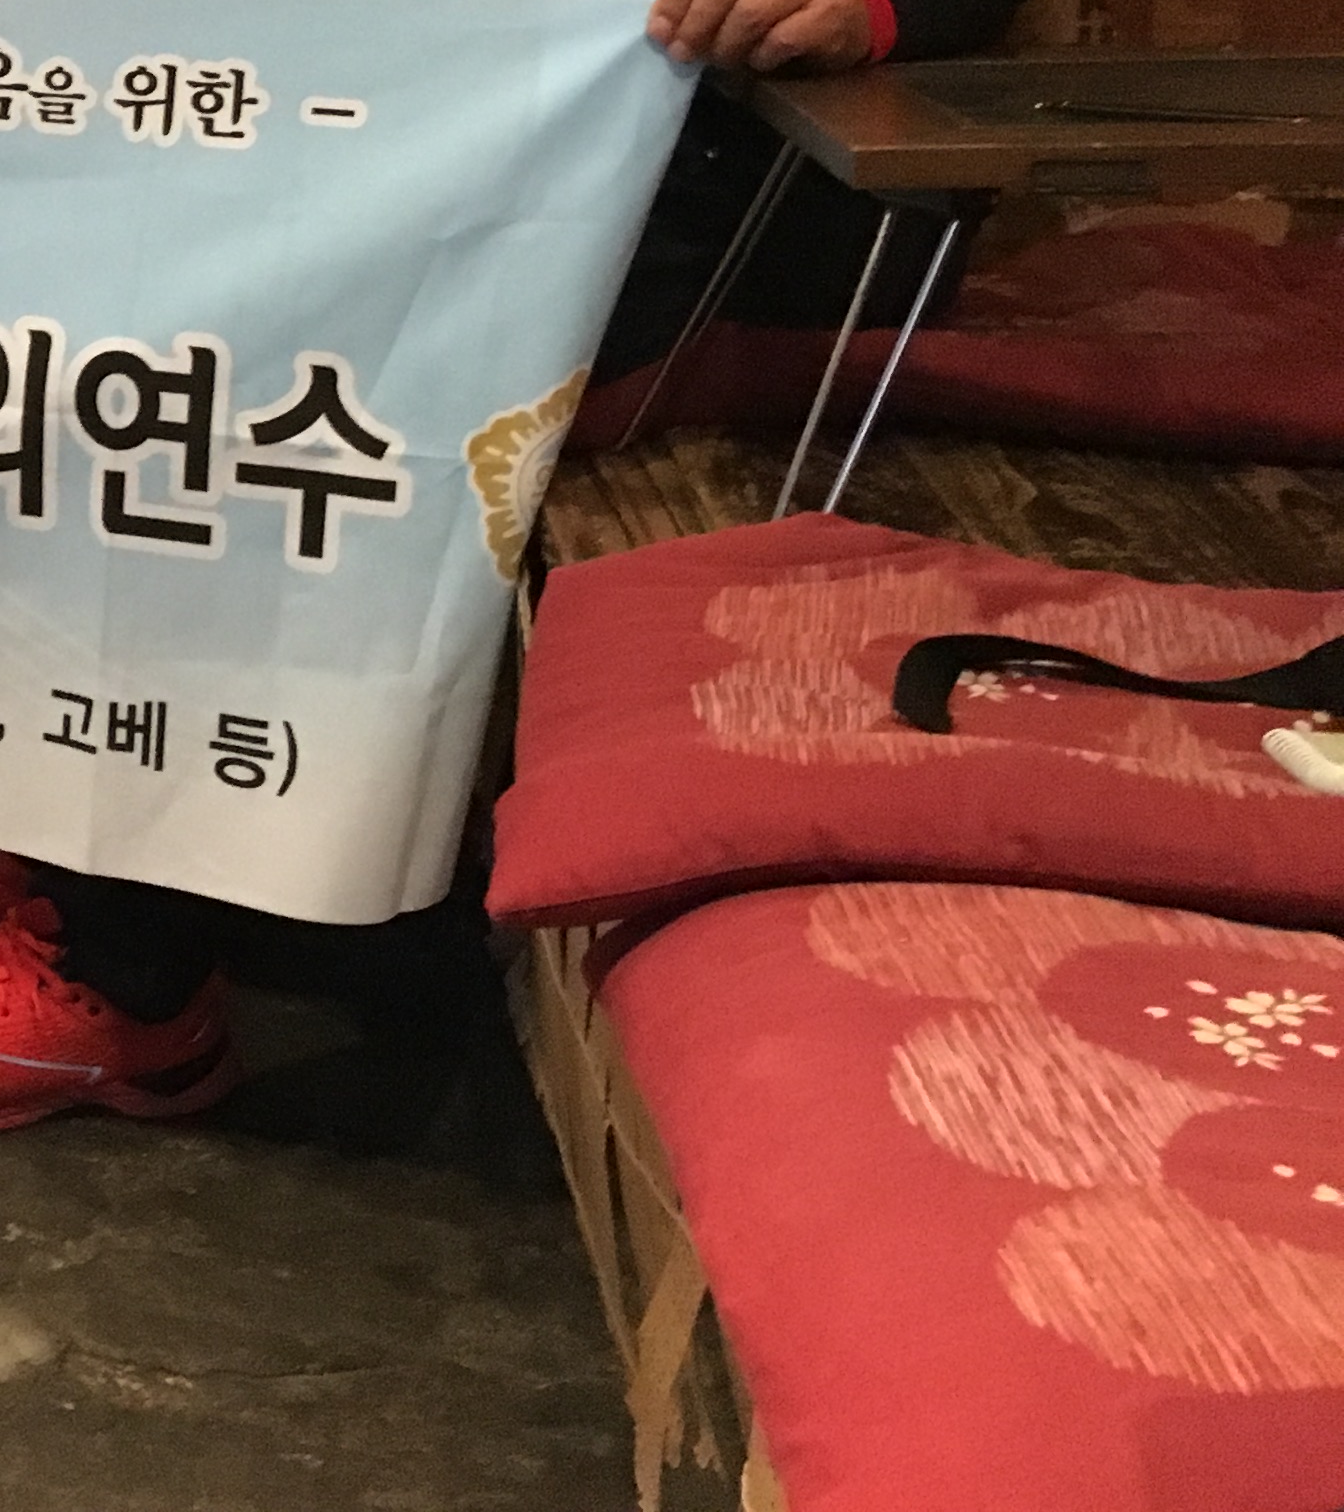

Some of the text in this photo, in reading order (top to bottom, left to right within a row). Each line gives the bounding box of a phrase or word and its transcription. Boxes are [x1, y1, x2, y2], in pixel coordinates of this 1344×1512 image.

[114, 64, 258, 138] 위한
[43, 690, 166, 771] 고베
[209, 713, 297, 796] 등)
